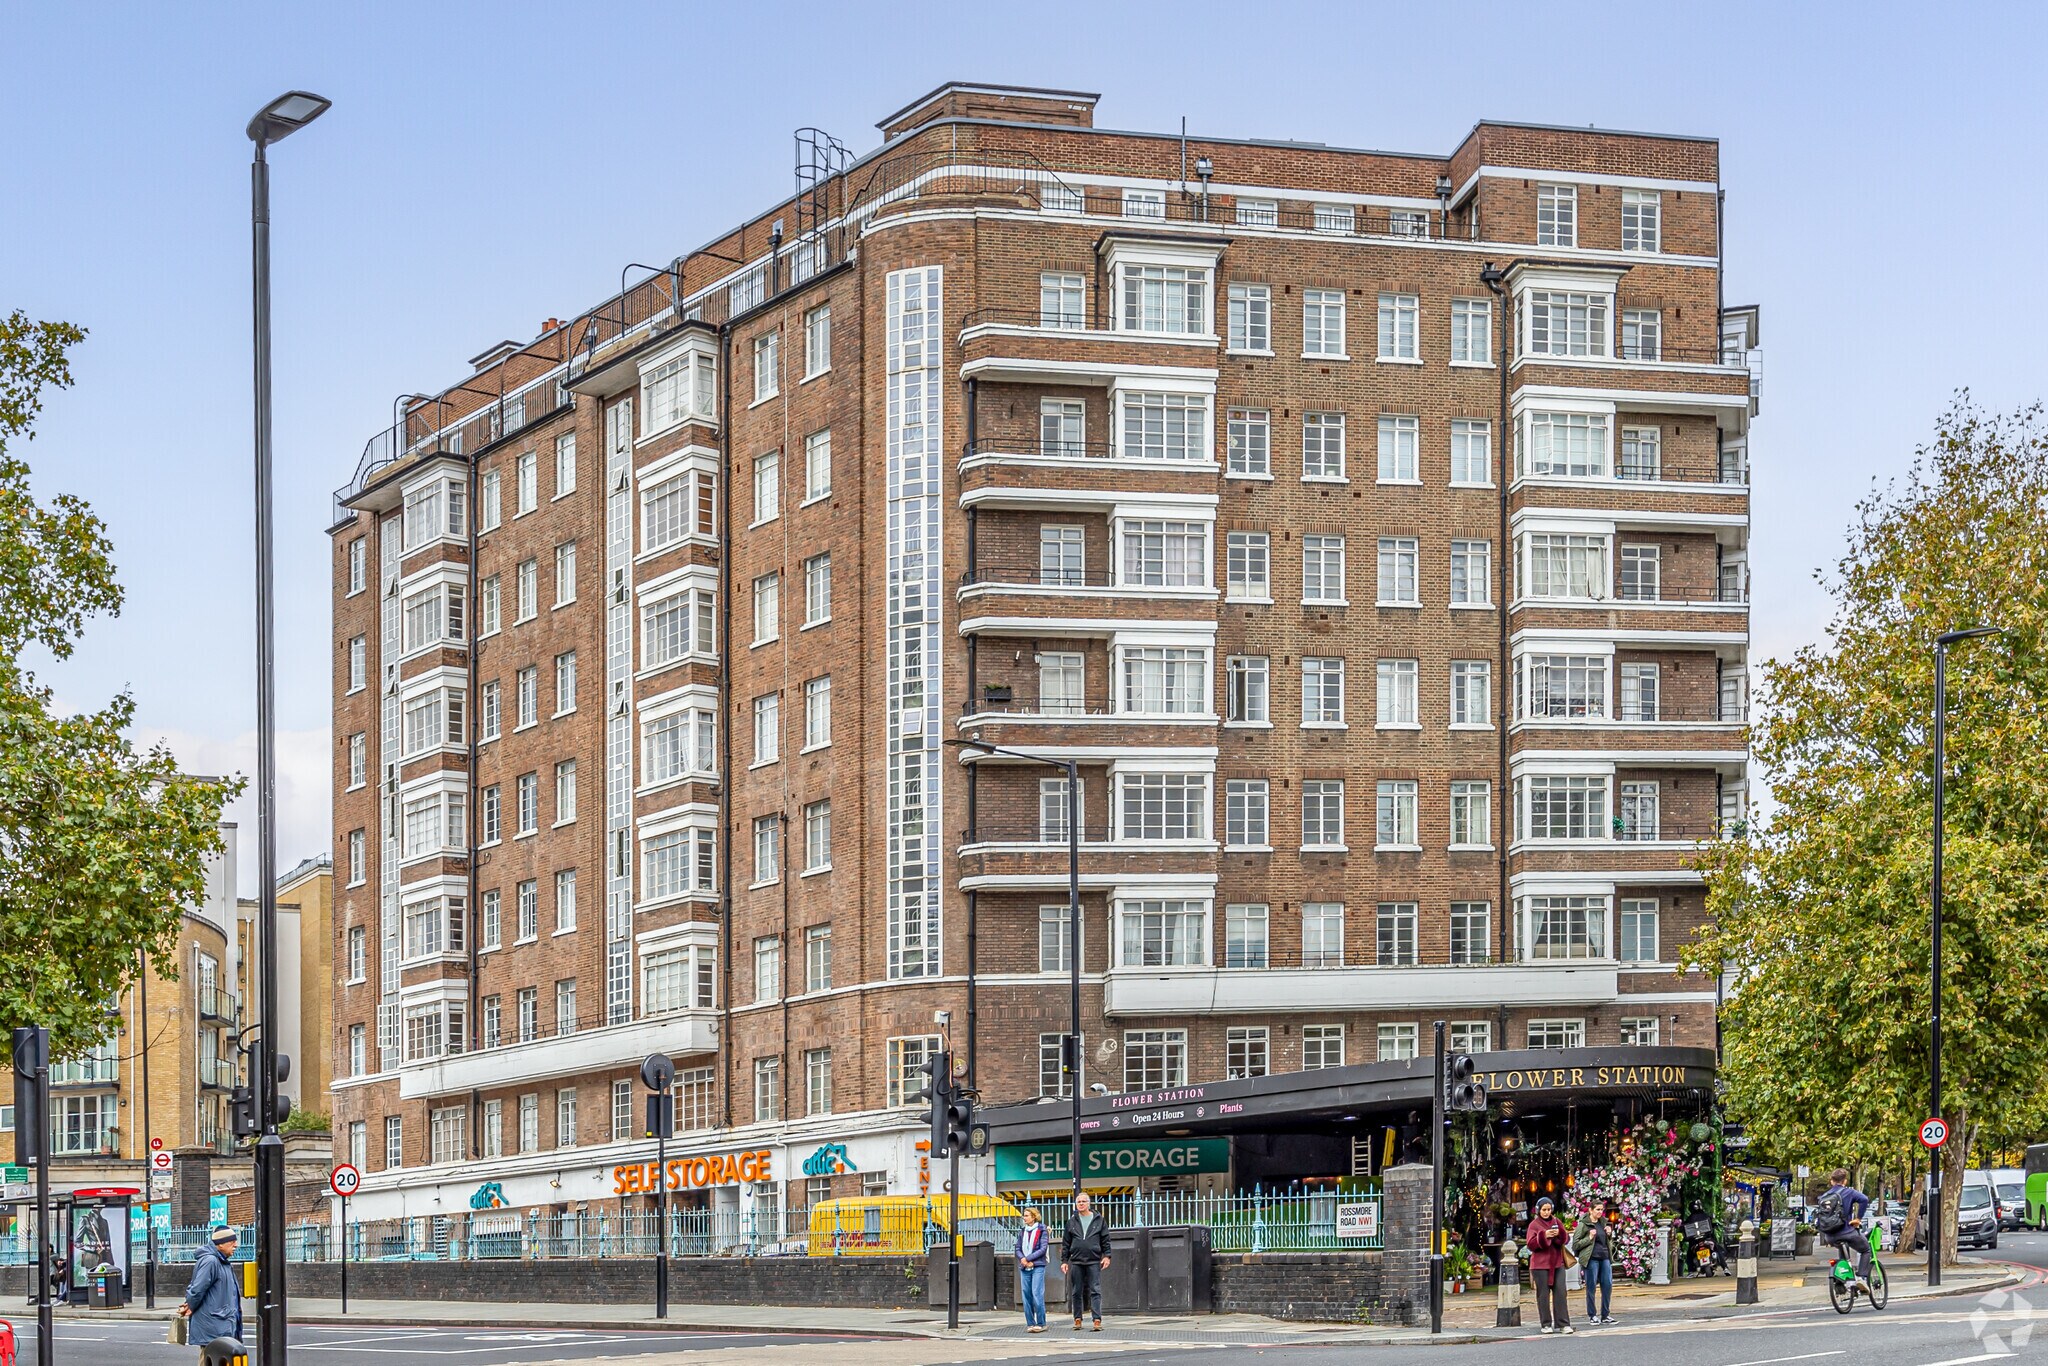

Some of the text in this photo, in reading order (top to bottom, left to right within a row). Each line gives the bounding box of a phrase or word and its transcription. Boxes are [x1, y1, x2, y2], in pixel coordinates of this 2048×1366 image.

[1471, 1066, 1686, 1091] FLOWER STATION
[1112, 1088, 1205, 1108] FLOWER STATION
[1219, 1103, 1243, 1114] Plants
[1132, 1110, 1185, 1125] Open 24 Hours
[1080, 1121, 1101, 1130] owers
[1923, 1126, 1944, 1139] 20
[803, 1146, 837, 1176] attic
[1088, 1147, 1200, 1171] STORAGE
[613, 1149, 772, 1195] SELF STORAGE
[336, 1173, 357, 1187] 20
[1340, 1206, 1373, 1217] ROSSMORE
[155, 1214, 170, 1228] FOR
[1340, 1216, 1373, 1227] ROAD NW1
